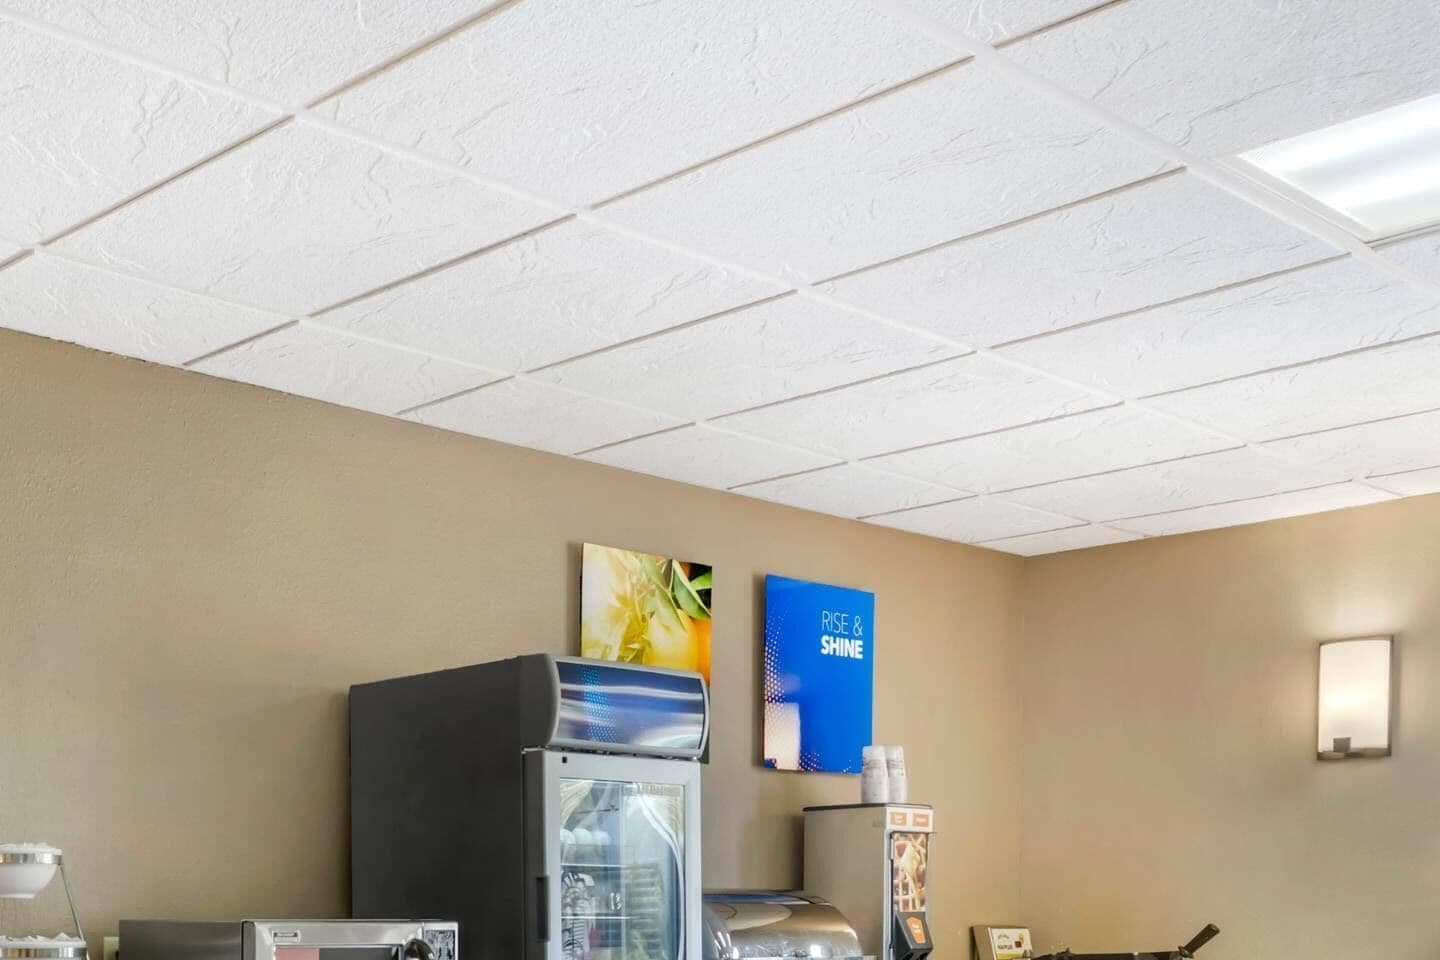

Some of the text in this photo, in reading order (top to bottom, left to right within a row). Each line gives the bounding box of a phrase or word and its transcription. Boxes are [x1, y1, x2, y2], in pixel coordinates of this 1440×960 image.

[822, 610, 863, 637] RISE &
[821, 634, 864, 659] SHINE
